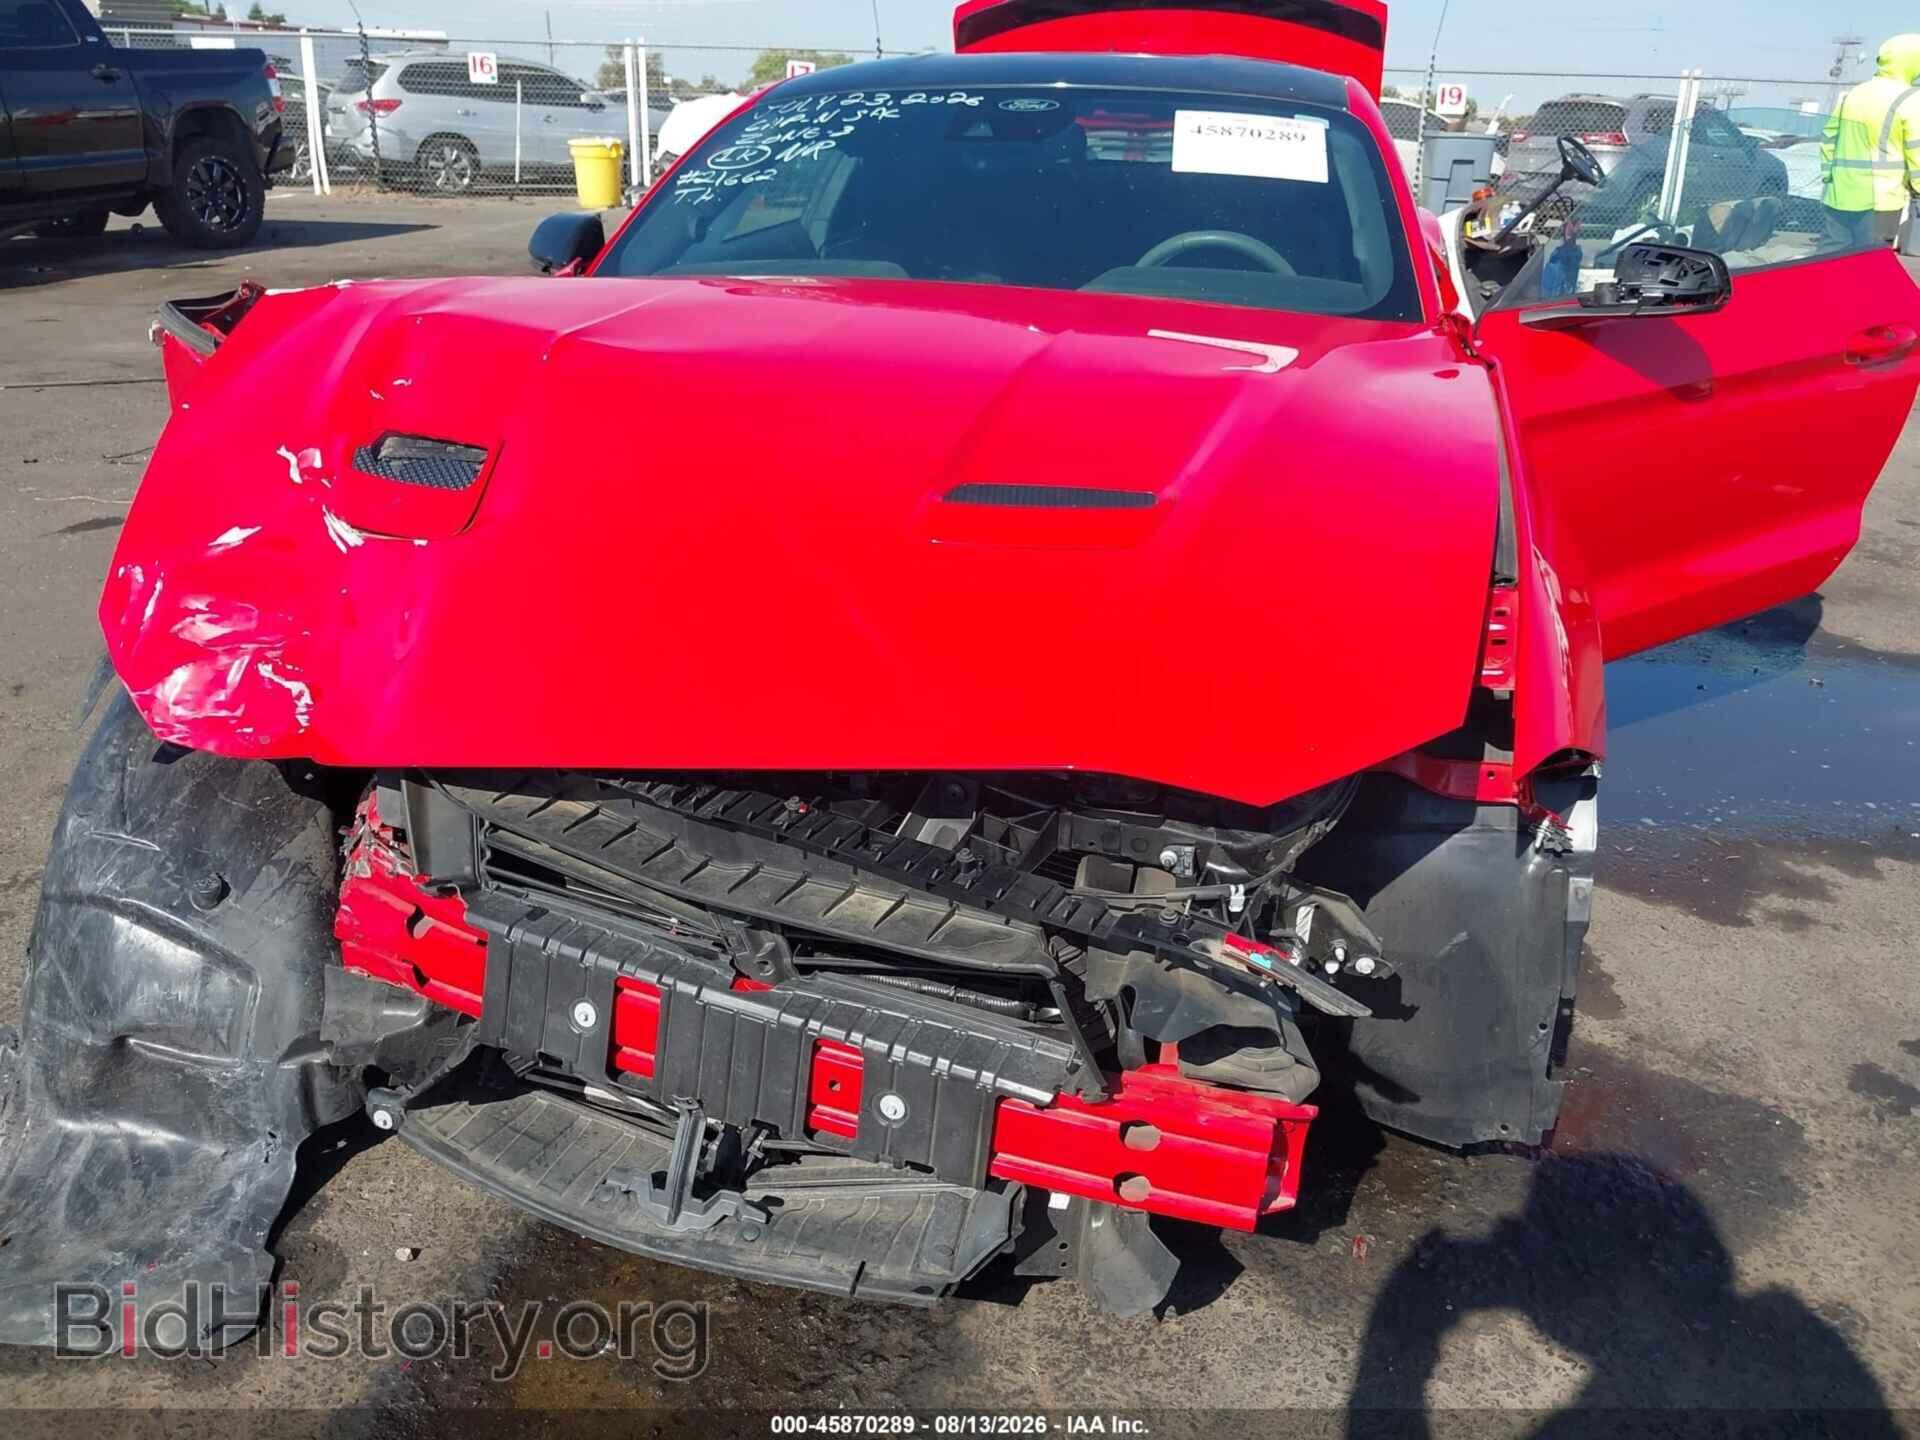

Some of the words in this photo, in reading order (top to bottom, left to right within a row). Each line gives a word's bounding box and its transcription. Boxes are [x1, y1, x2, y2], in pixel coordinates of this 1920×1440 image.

[472, 55, 493, 74] 16
[1440, 86, 1463, 105] 19
[1190, 124, 1307, 142] 45870289
